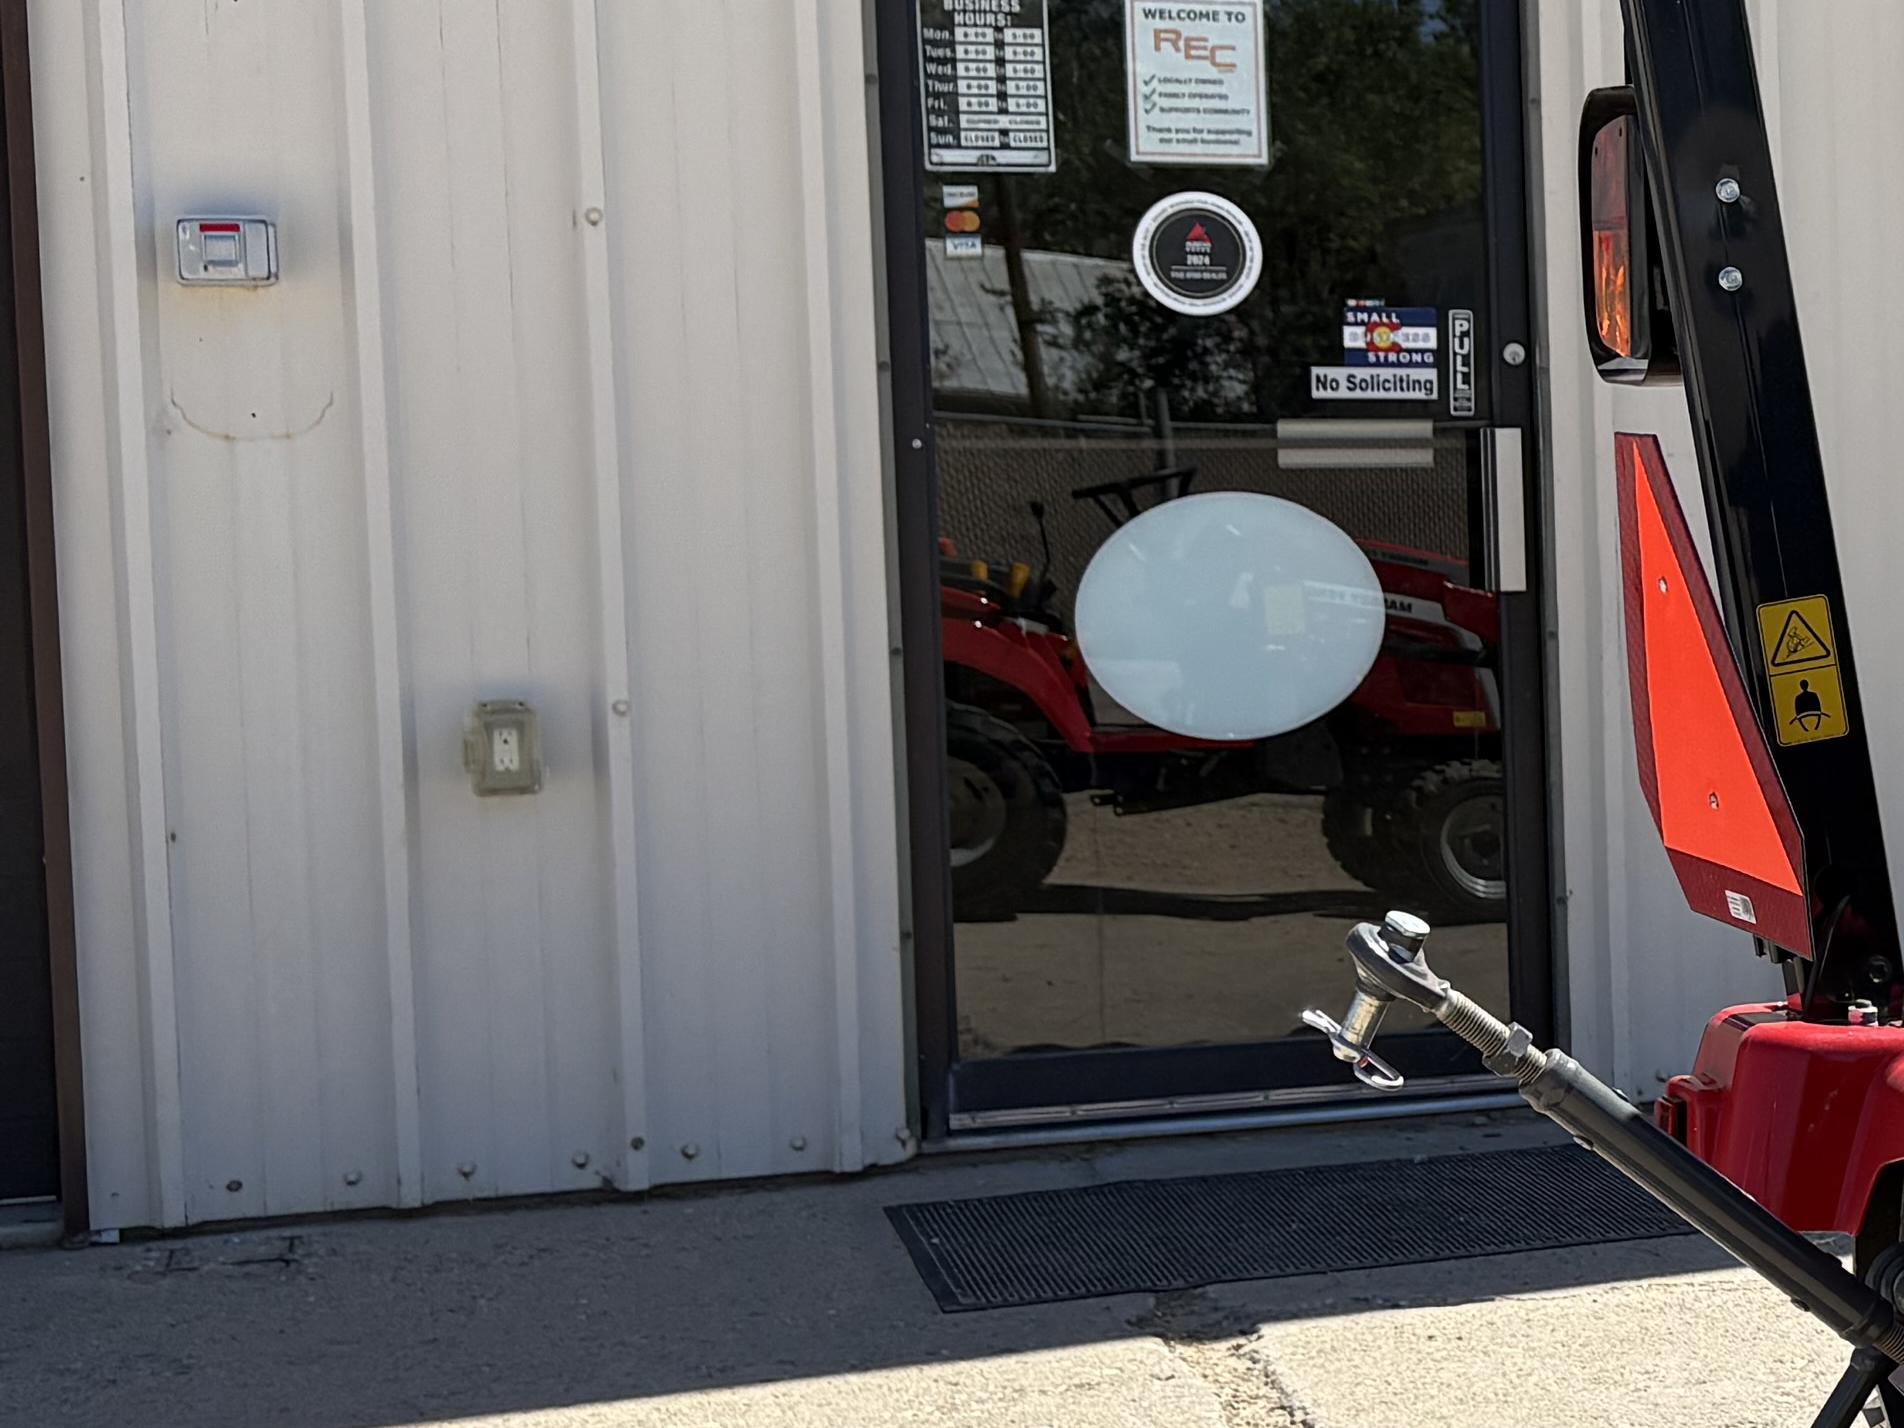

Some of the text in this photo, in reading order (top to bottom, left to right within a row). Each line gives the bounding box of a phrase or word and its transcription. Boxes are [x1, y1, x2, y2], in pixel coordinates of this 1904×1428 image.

[954, 11, 1011, 27] HOURS:
[1143, 7, 1246, 23] WELCOME TO
[1153, 28, 1237, 73] REC
[964, 134, 995, 143] CLOSED
[1012, 134, 1043, 143] CLOSED
[1346, 312, 1400, 323] SMALL
[1367, 352, 1434, 363] STRONG
[1454, 319, 1469, 390] PULL
[1315, 373, 1434, 397] No Soliciting
